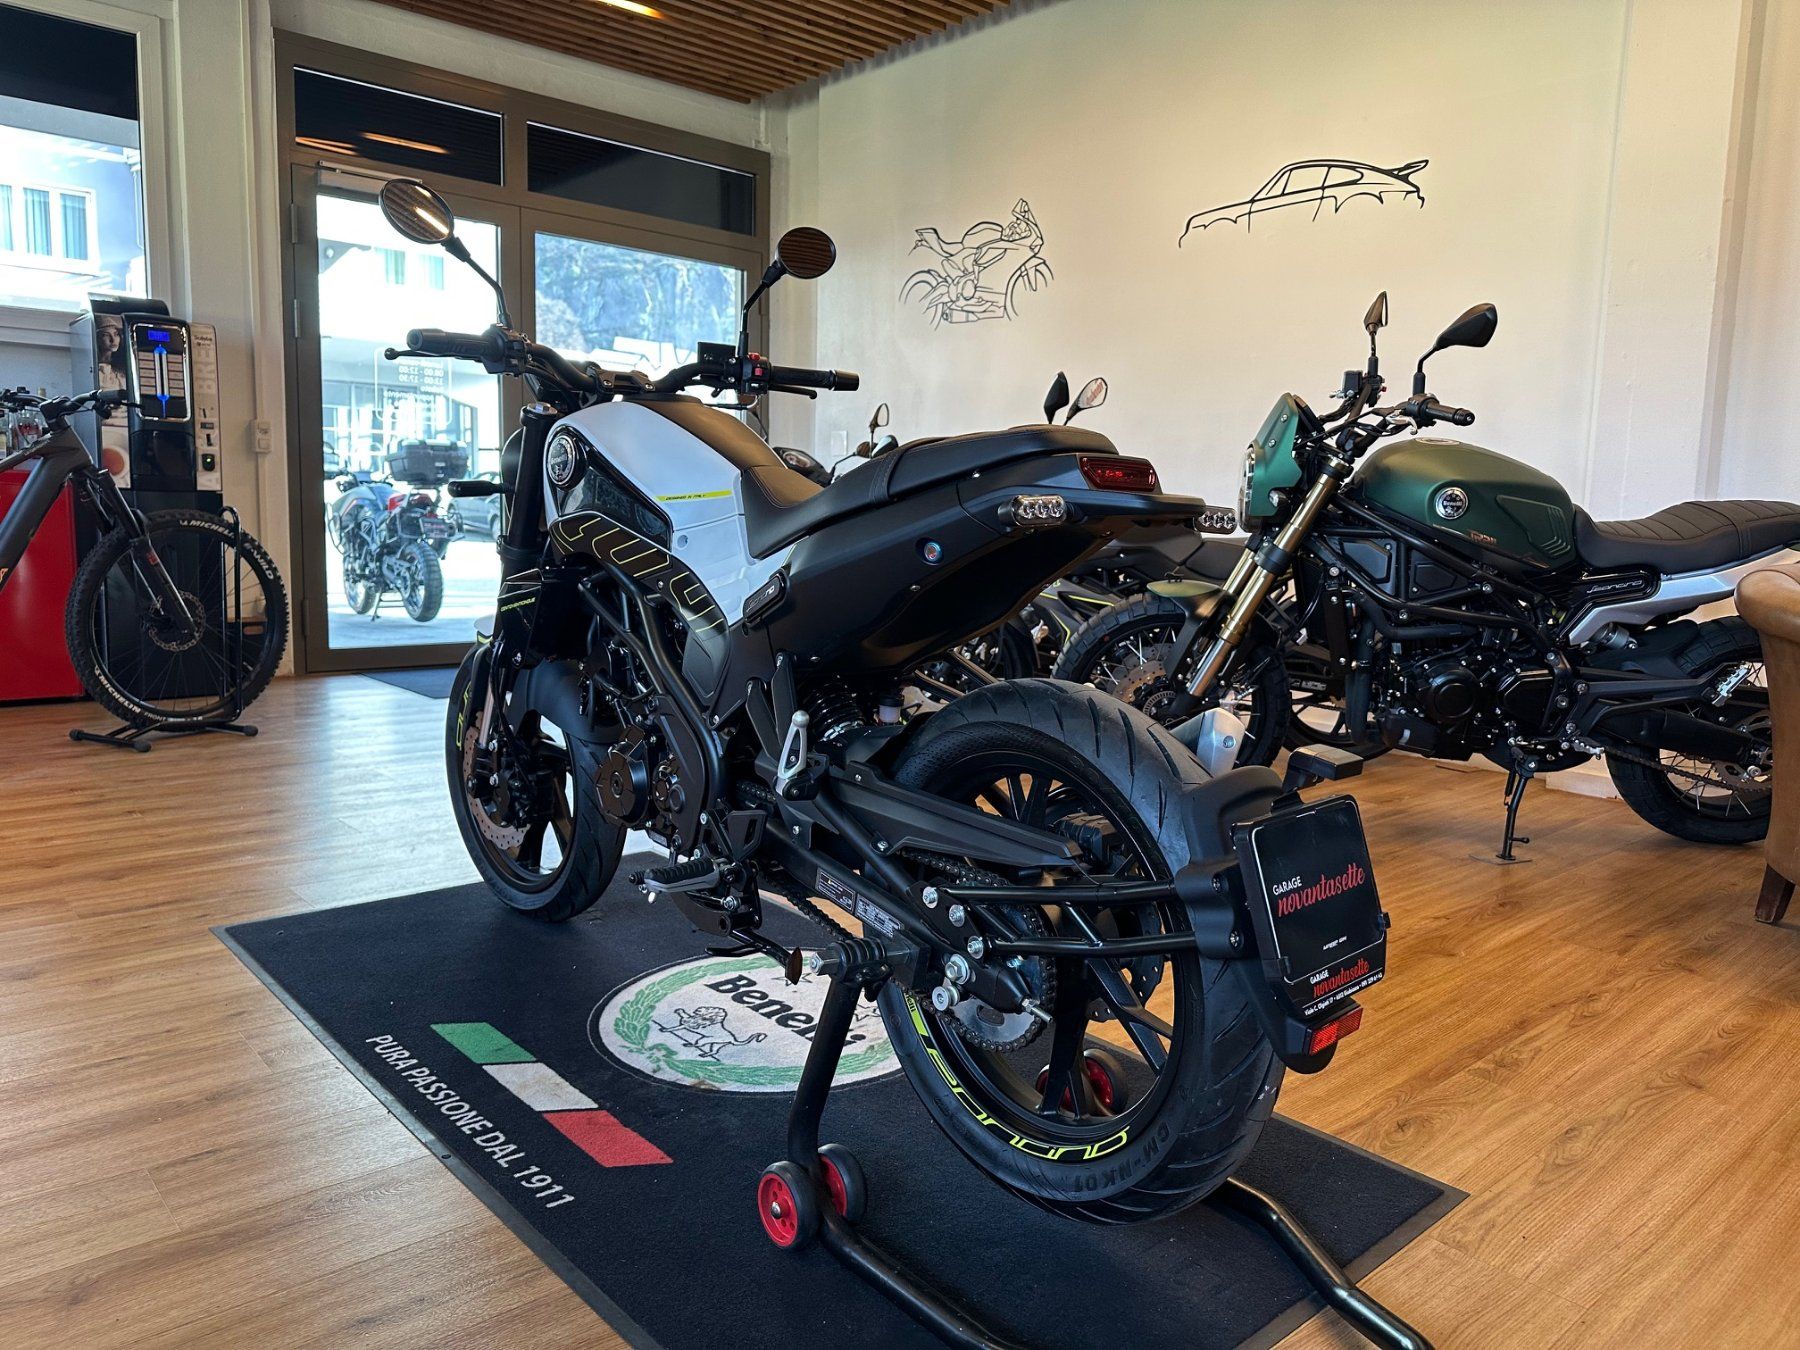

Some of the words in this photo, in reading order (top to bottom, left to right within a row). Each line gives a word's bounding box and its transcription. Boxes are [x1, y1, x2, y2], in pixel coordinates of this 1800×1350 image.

[188, 520, 236, 539] MICHELI
[99, 675, 142, 714] MICHELIN
[144, 711, 166, 721] FRONT
[1272, 876, 1303, 896] GARAGE
[1278, 862, 1366, 918] novantasette
[1309, 969, 1330, 985] GARAGE
[365, 1034, 418, 1071] PURA
[401, 1066, 493, 1135] PASSIONE
[472, 1130, 526, 1168] DAL
[513, 1165, 575, 1209] 1911
